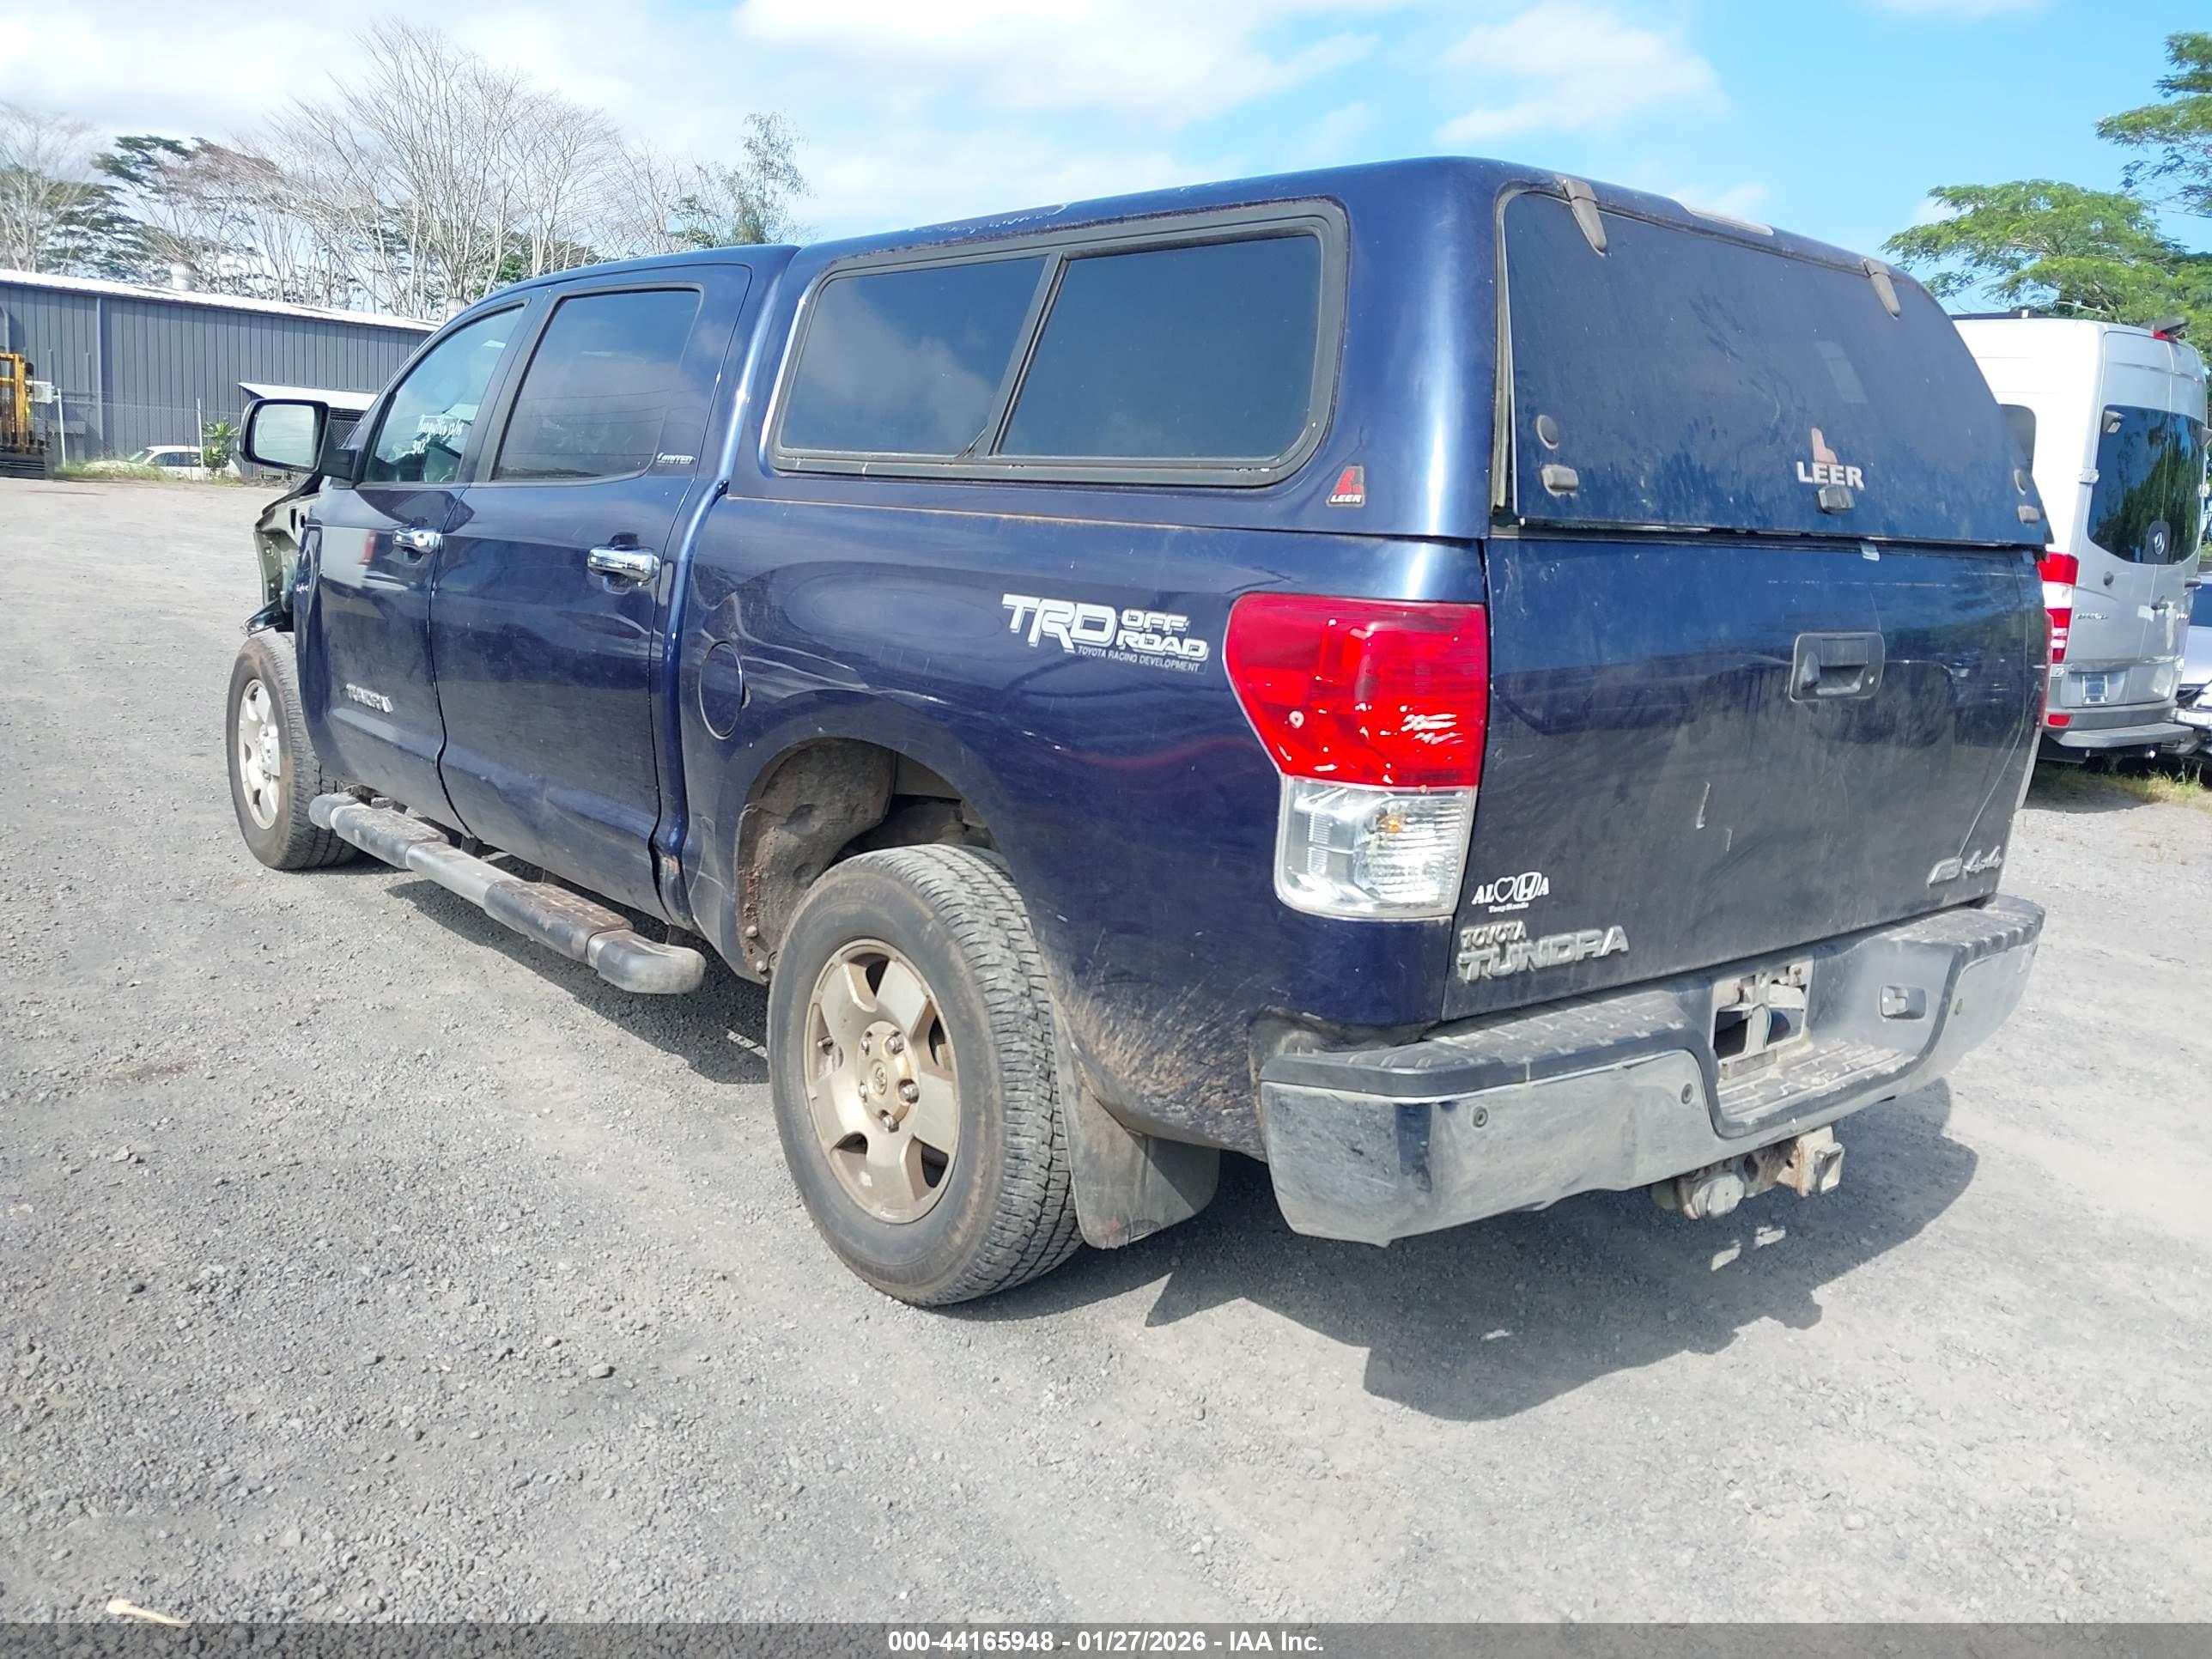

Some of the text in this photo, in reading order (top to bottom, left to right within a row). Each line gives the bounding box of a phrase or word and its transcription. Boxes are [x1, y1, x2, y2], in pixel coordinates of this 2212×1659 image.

[1796, 461, 1865, 490] LEER
[1330, 494, 1362, 503] LEER
[1002, 593, 1190, 653] TRD OFF
[1079, 645, 1200, 672] TOYOTA RACING DEVELOPMENT
[1116, 631, 1209, 661] ROAD
[1460, 921, 1527, 950] TOYOTA
[1457, 925, 1630, 982] TUNDRA
